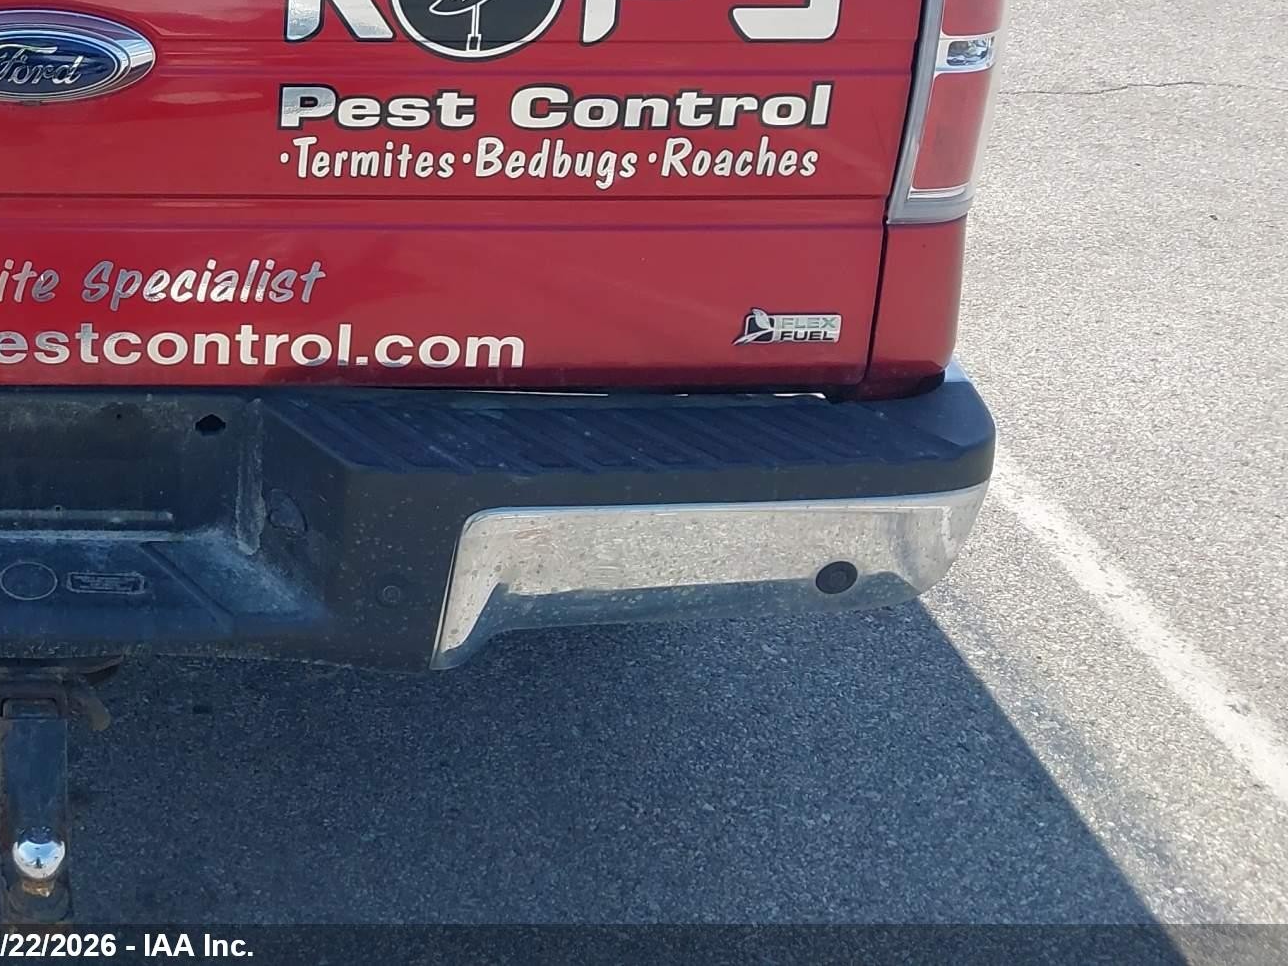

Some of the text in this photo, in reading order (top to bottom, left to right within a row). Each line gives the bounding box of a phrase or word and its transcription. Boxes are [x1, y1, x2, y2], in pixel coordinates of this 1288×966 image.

[278, 81, 835, 131] Pest Control
[81, 258, 327, 312] Specialist
[780, 330, 835, 341] FUEL
[781, 317, 837, 329] FLEX
